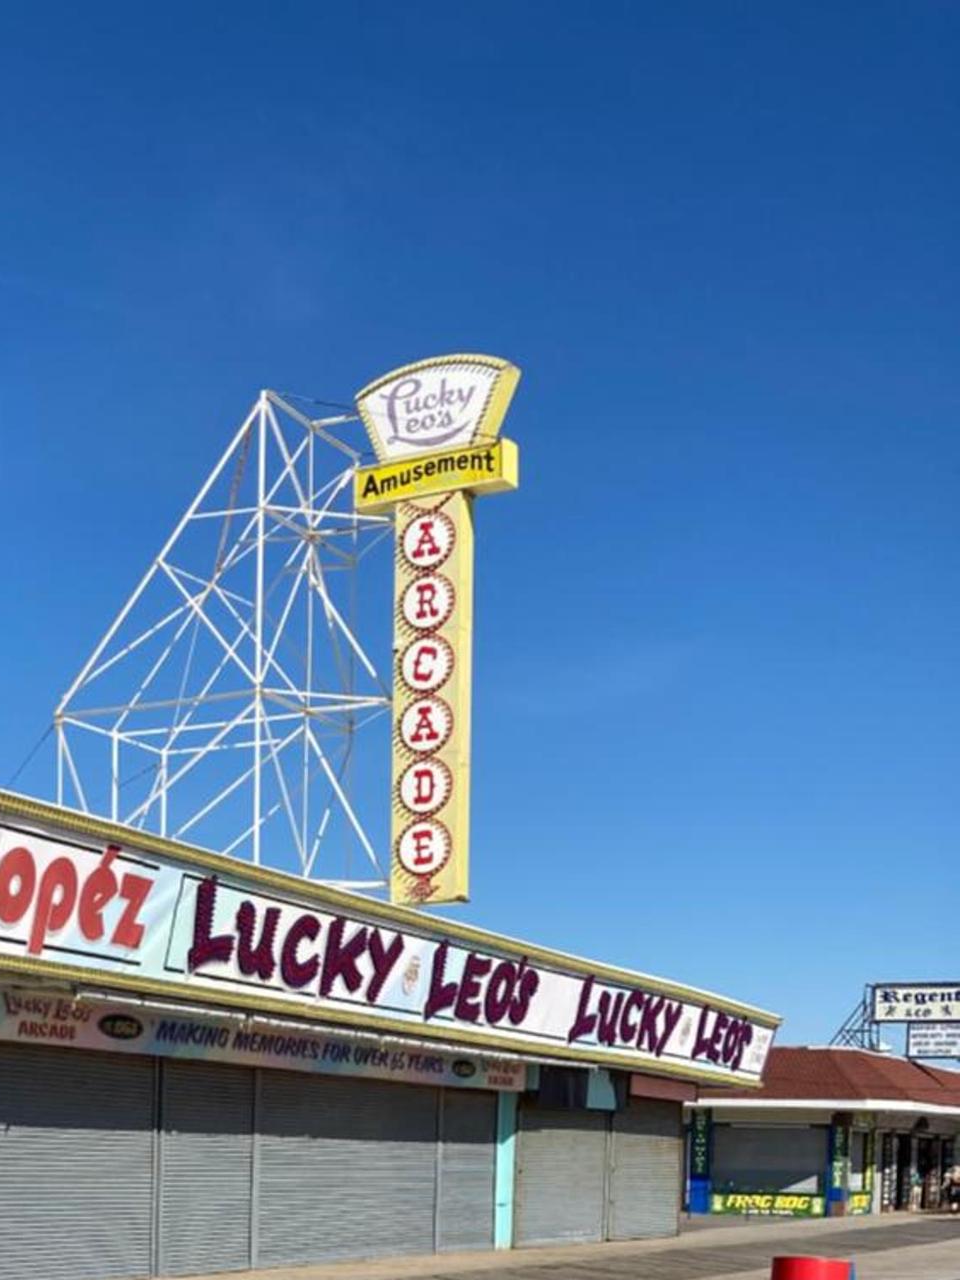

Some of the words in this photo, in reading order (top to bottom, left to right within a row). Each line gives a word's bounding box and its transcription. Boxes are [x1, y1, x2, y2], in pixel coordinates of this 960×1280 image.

[380, 377, 477, 438] Lucky
[361, 449, 496, 499] Amusement
[410, 521, 441, 865] ARCADE
[424, 939, 540, 1026] LEO'S
[17, 1020, 77, 1041] ARCADE
[155, 1019, 229, 1048] MAKING
[232, 1030, 319, 1061] MEMORIES
[321, 1040, 351, 1063] FOR
[353, 1046, 390, 1068] OVER
[406, 1050, 444, 1075] YEARS
